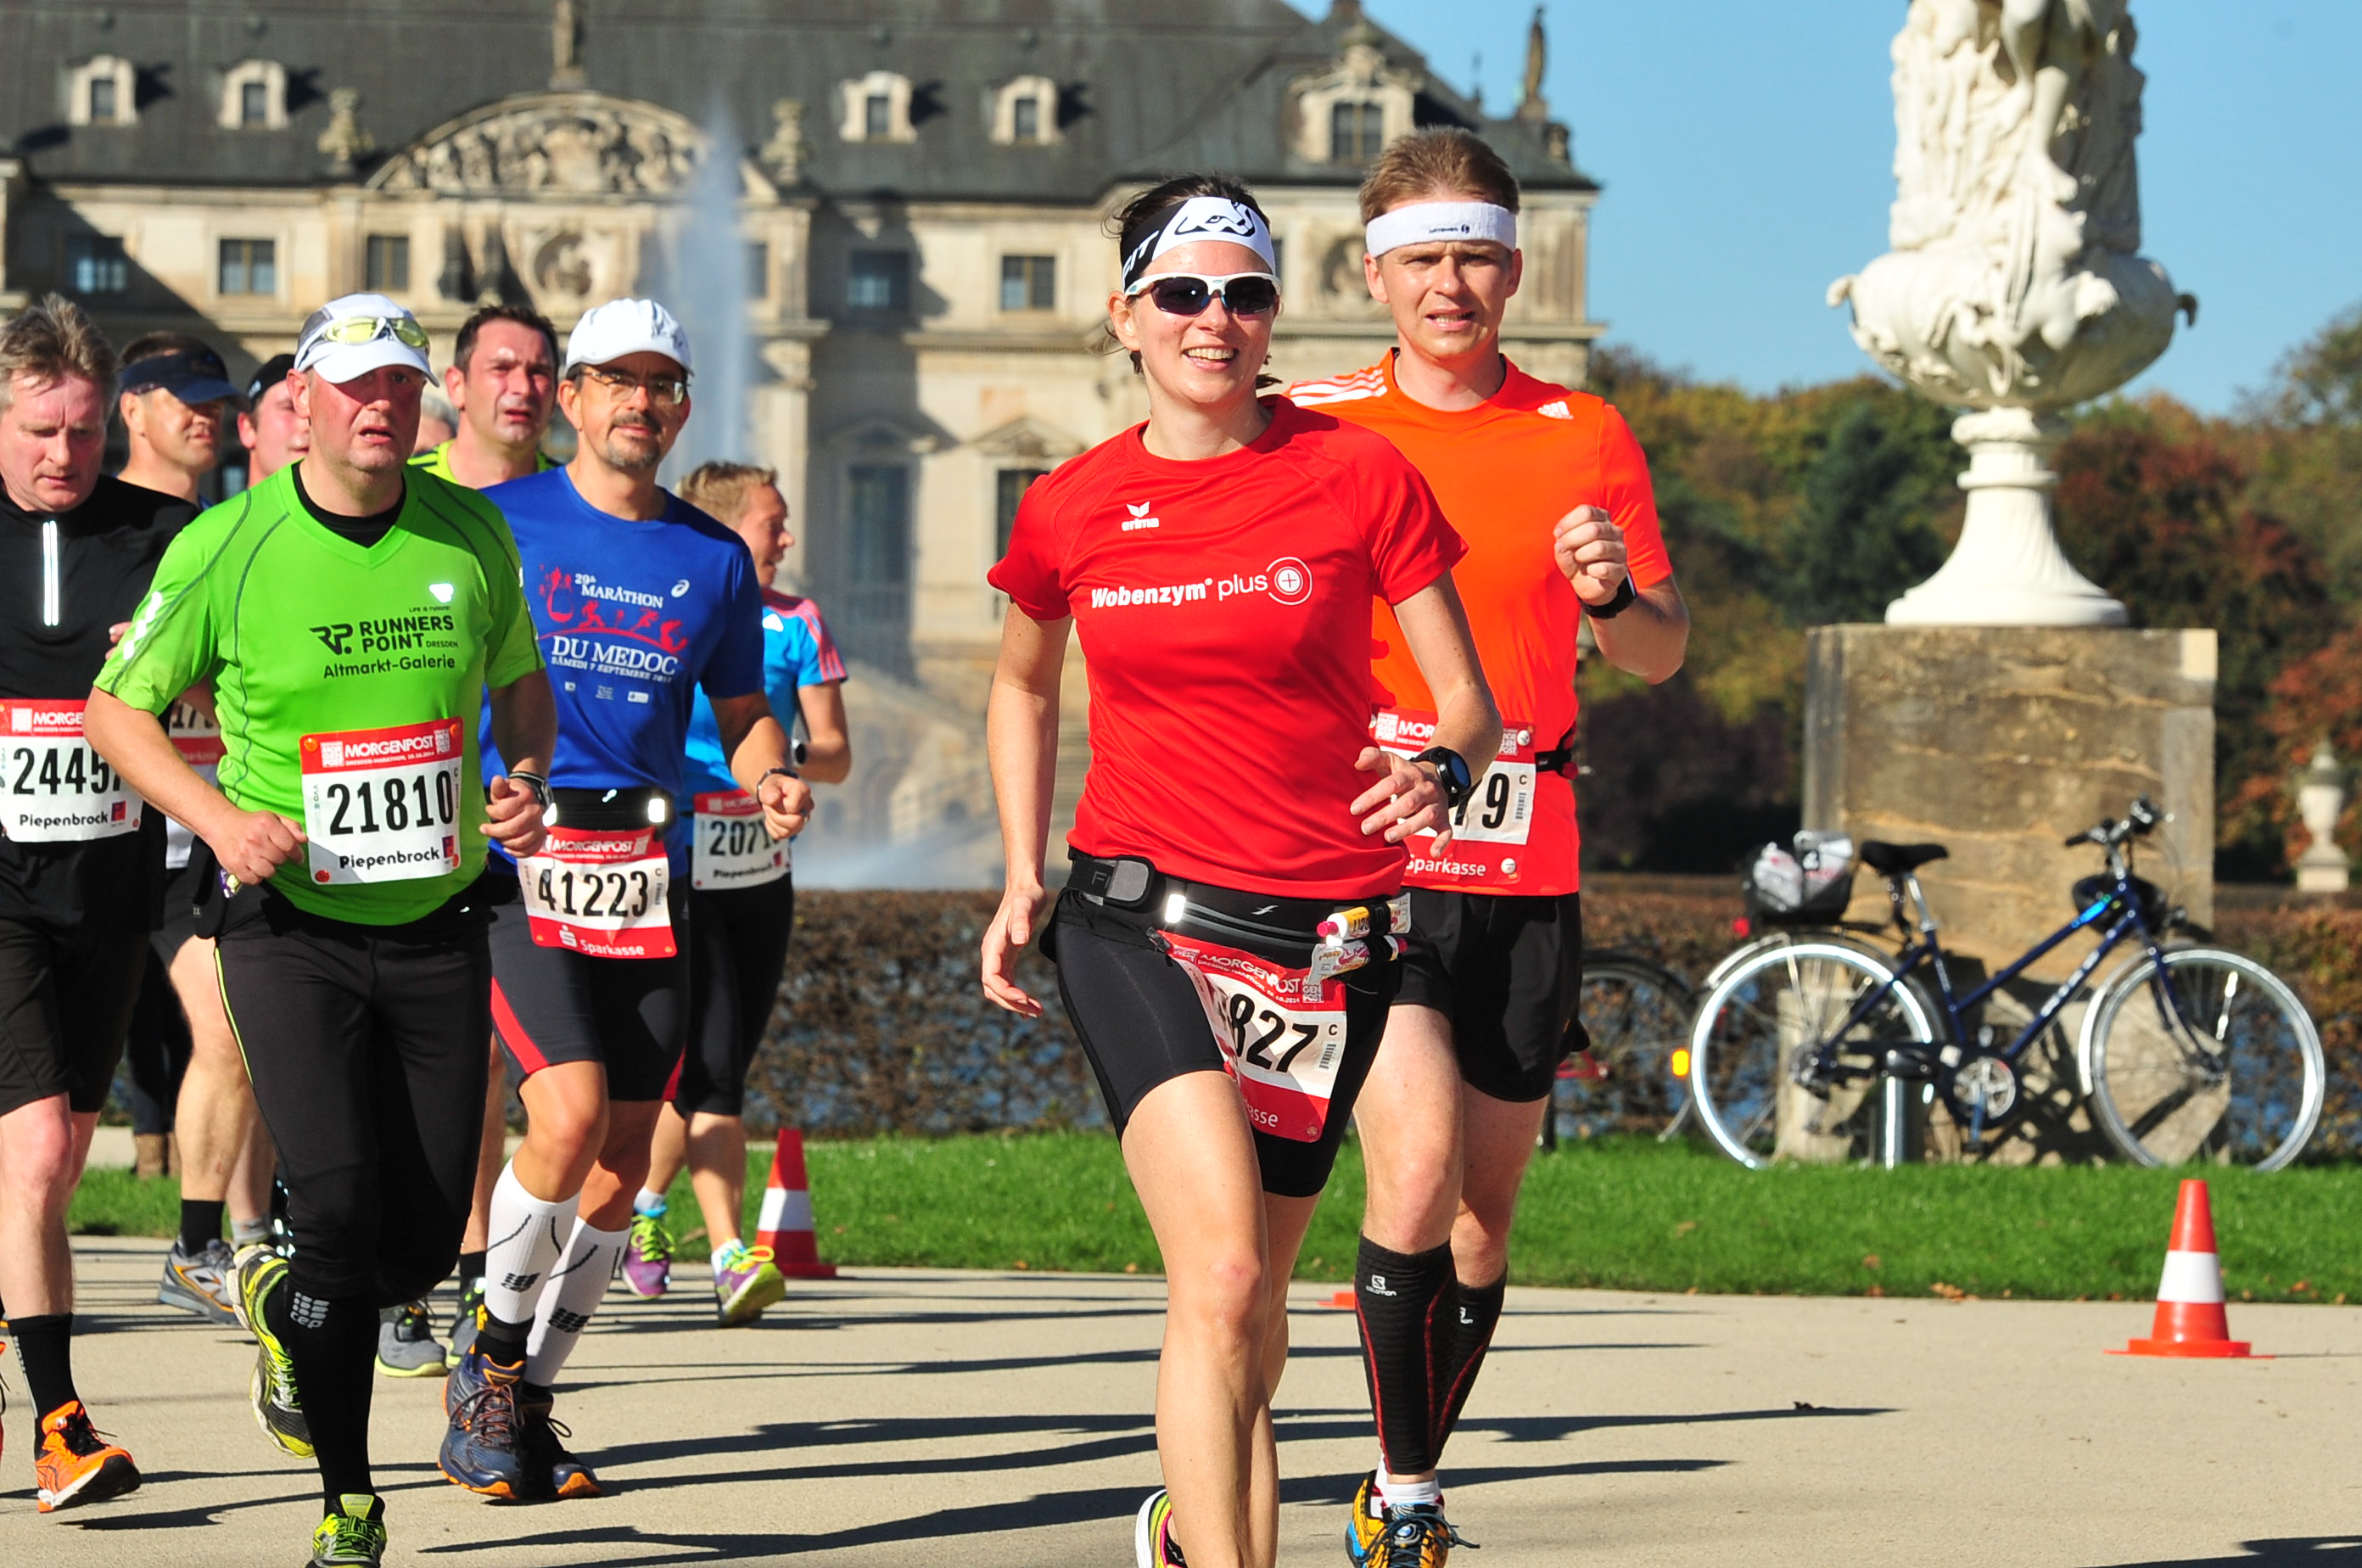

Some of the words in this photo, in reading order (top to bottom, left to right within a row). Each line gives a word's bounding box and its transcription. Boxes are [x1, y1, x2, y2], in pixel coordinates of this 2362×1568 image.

[1122, 518, 1160, 532] erima
[581, 585, 664, 609] MARATHON
[1217, 574, 1268, 602] plus
[360, 615, 455, 636] RUNNERS
[362, 633, 425, 653] POINT
[323, 653, 456, 679] Altmarkt-Galerie
[551, 636, 590, 659] DU
[592, 642, 679, 675] MEDOC
[551, 656, 587, 670] SAMEDI
[597, 664, 651, 680] SEPTEMBRE
[344, 735, 434, 758] MORGENPOST
[1519, 774, 1528, 785] C
[327, 770, 453, 837] 21810
[20, 811, 109, 830] Piepenbrock
[552, 839, 635, 853] MORGENPOST
[339, 847, 439, 870] Piepenbrock
[1406, 854, 1486, 877] Sparkasse
[654, 867, 662, 877] C
[538, 868, 648, 917] 41223
[579, 938, 645, 956] Sparkasse
[1201, 954, 1301, 994] MORGENPOST
[1328, 1024, 1338, 1036] C
